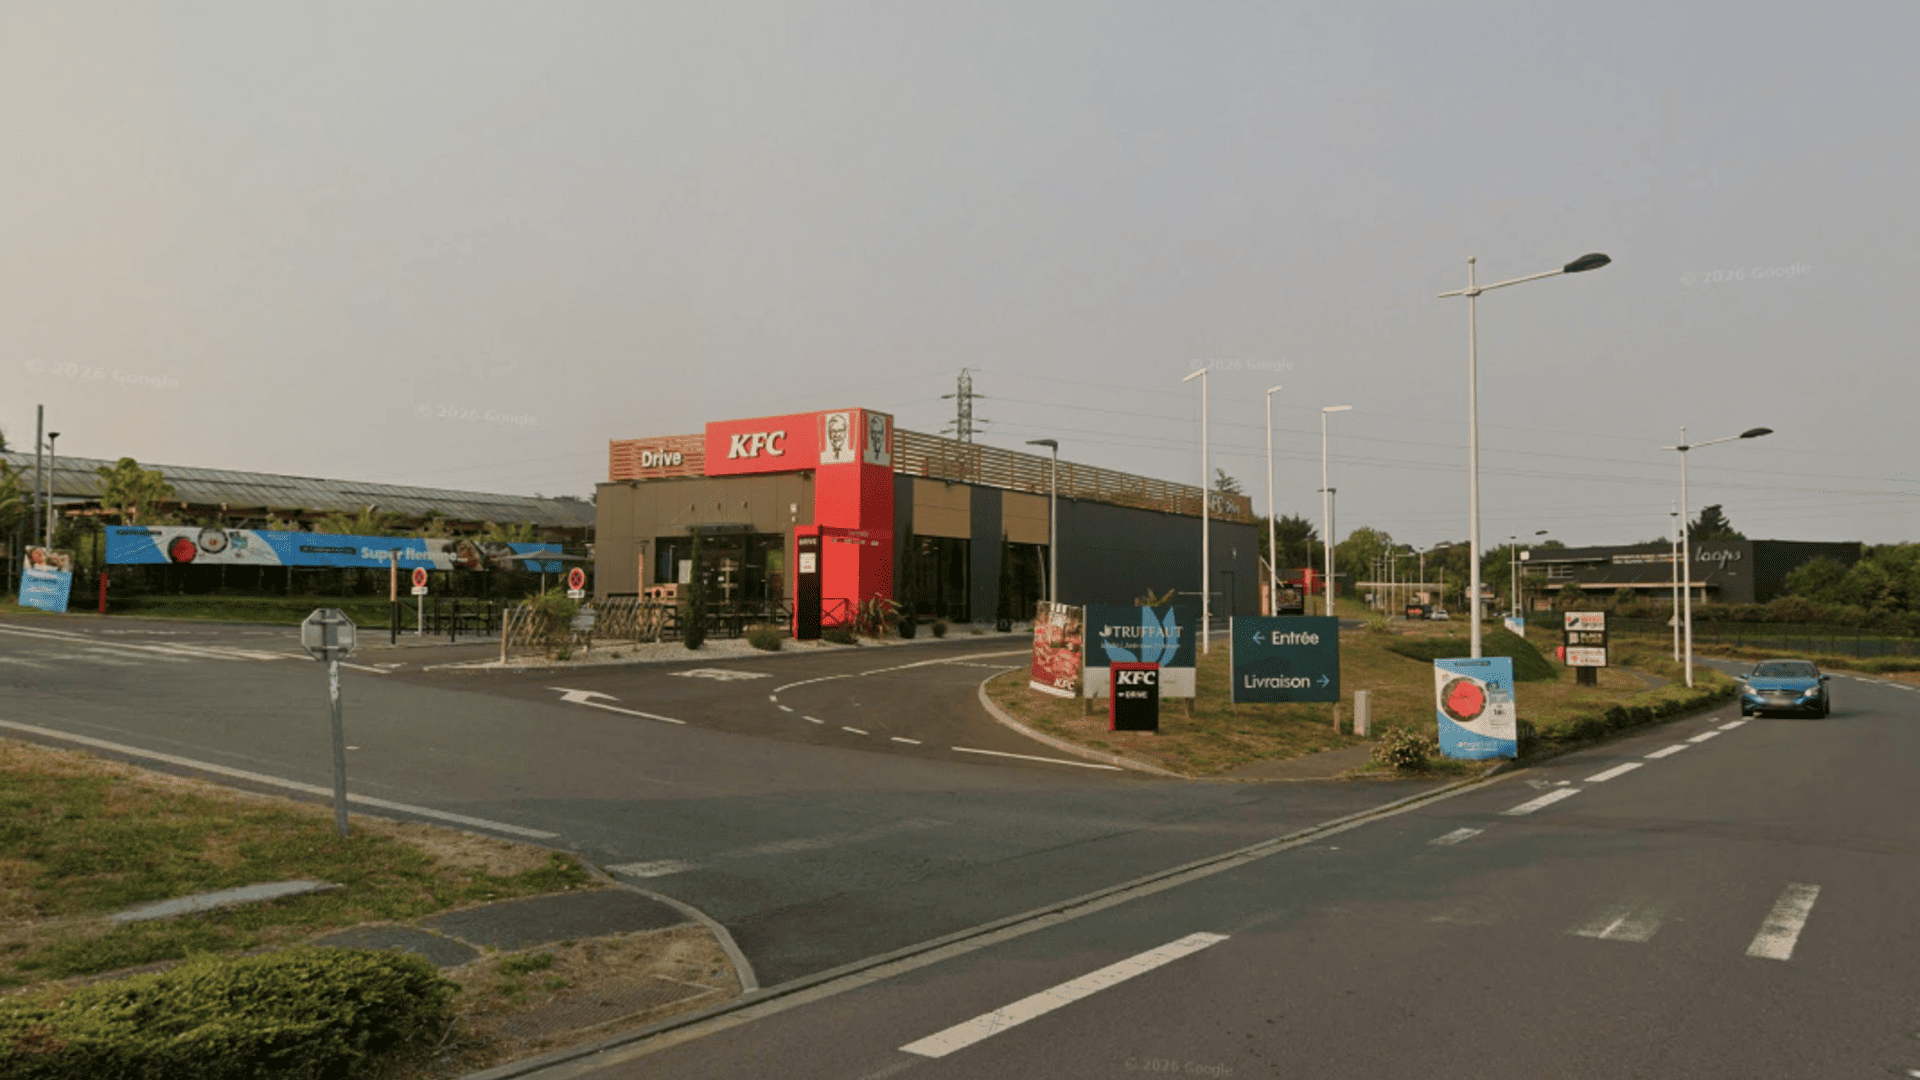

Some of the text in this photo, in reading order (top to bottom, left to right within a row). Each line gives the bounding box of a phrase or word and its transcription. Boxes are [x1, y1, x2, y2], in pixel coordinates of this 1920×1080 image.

[727, 430, 787, 459] KFC
[641, 448, 683, 468] Drive
[1694, 545, 1741, 569] loops
[1113, 625, 1184, 638] TRUFFAUT
[1271, 630, 1320, 646] Entrée
[1053, 678, 1075, 691] KFC
[1116, 671, 1156, 686] KFC
[1244, 673, 1311, 690] Livraison
